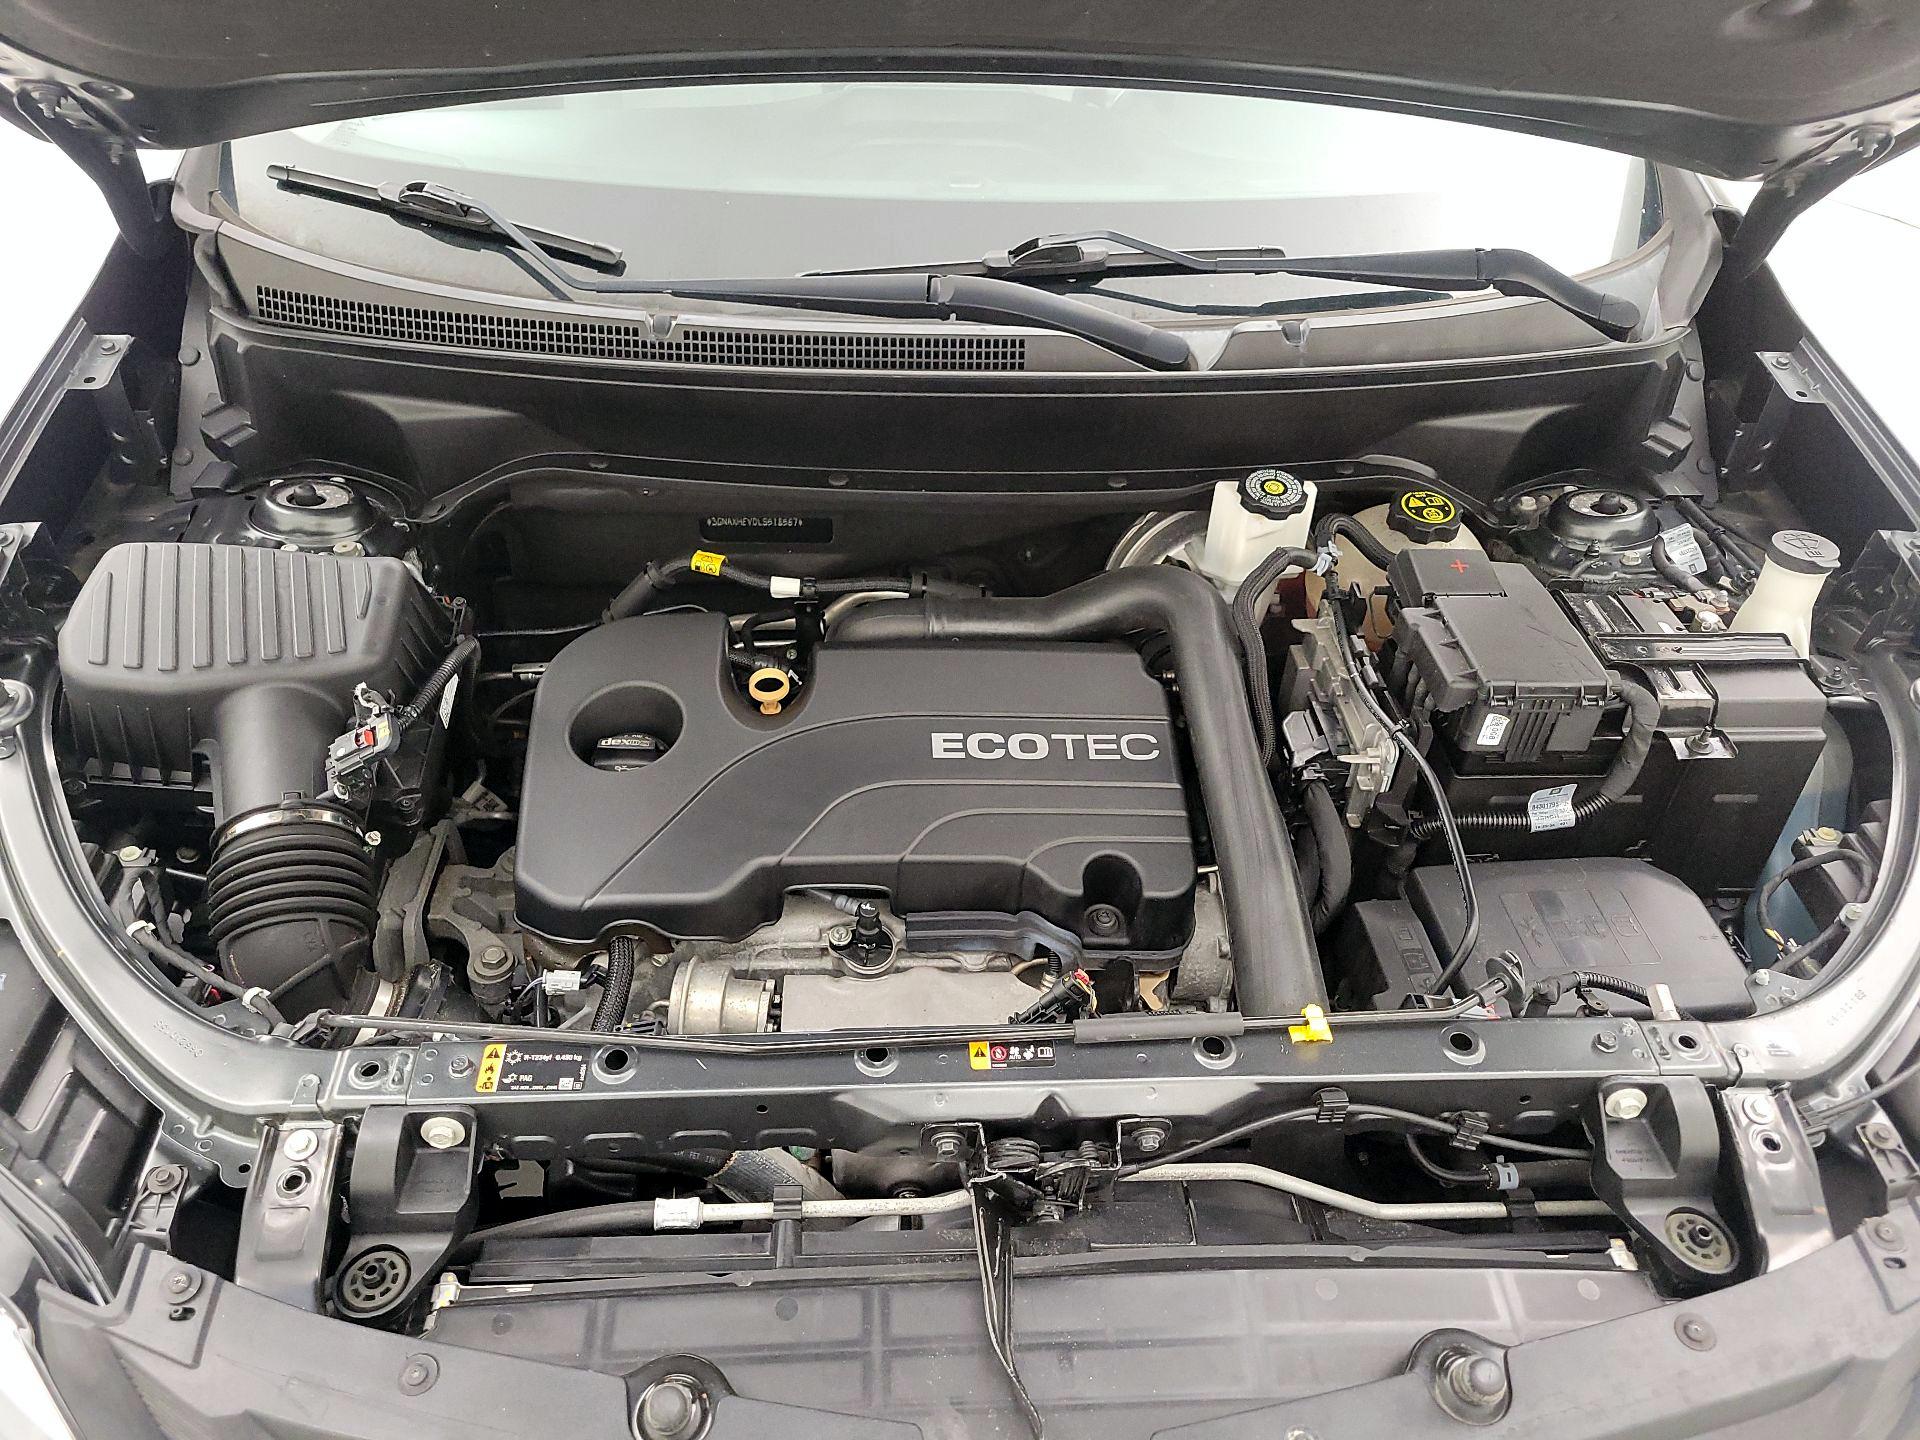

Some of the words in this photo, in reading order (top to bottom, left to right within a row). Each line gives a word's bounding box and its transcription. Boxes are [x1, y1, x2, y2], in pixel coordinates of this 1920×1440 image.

[601, 738, 650, 746] dexos
[931, 732, 1160, 761] ECOTEC
[519, 1074, 533, 1082] PAG
